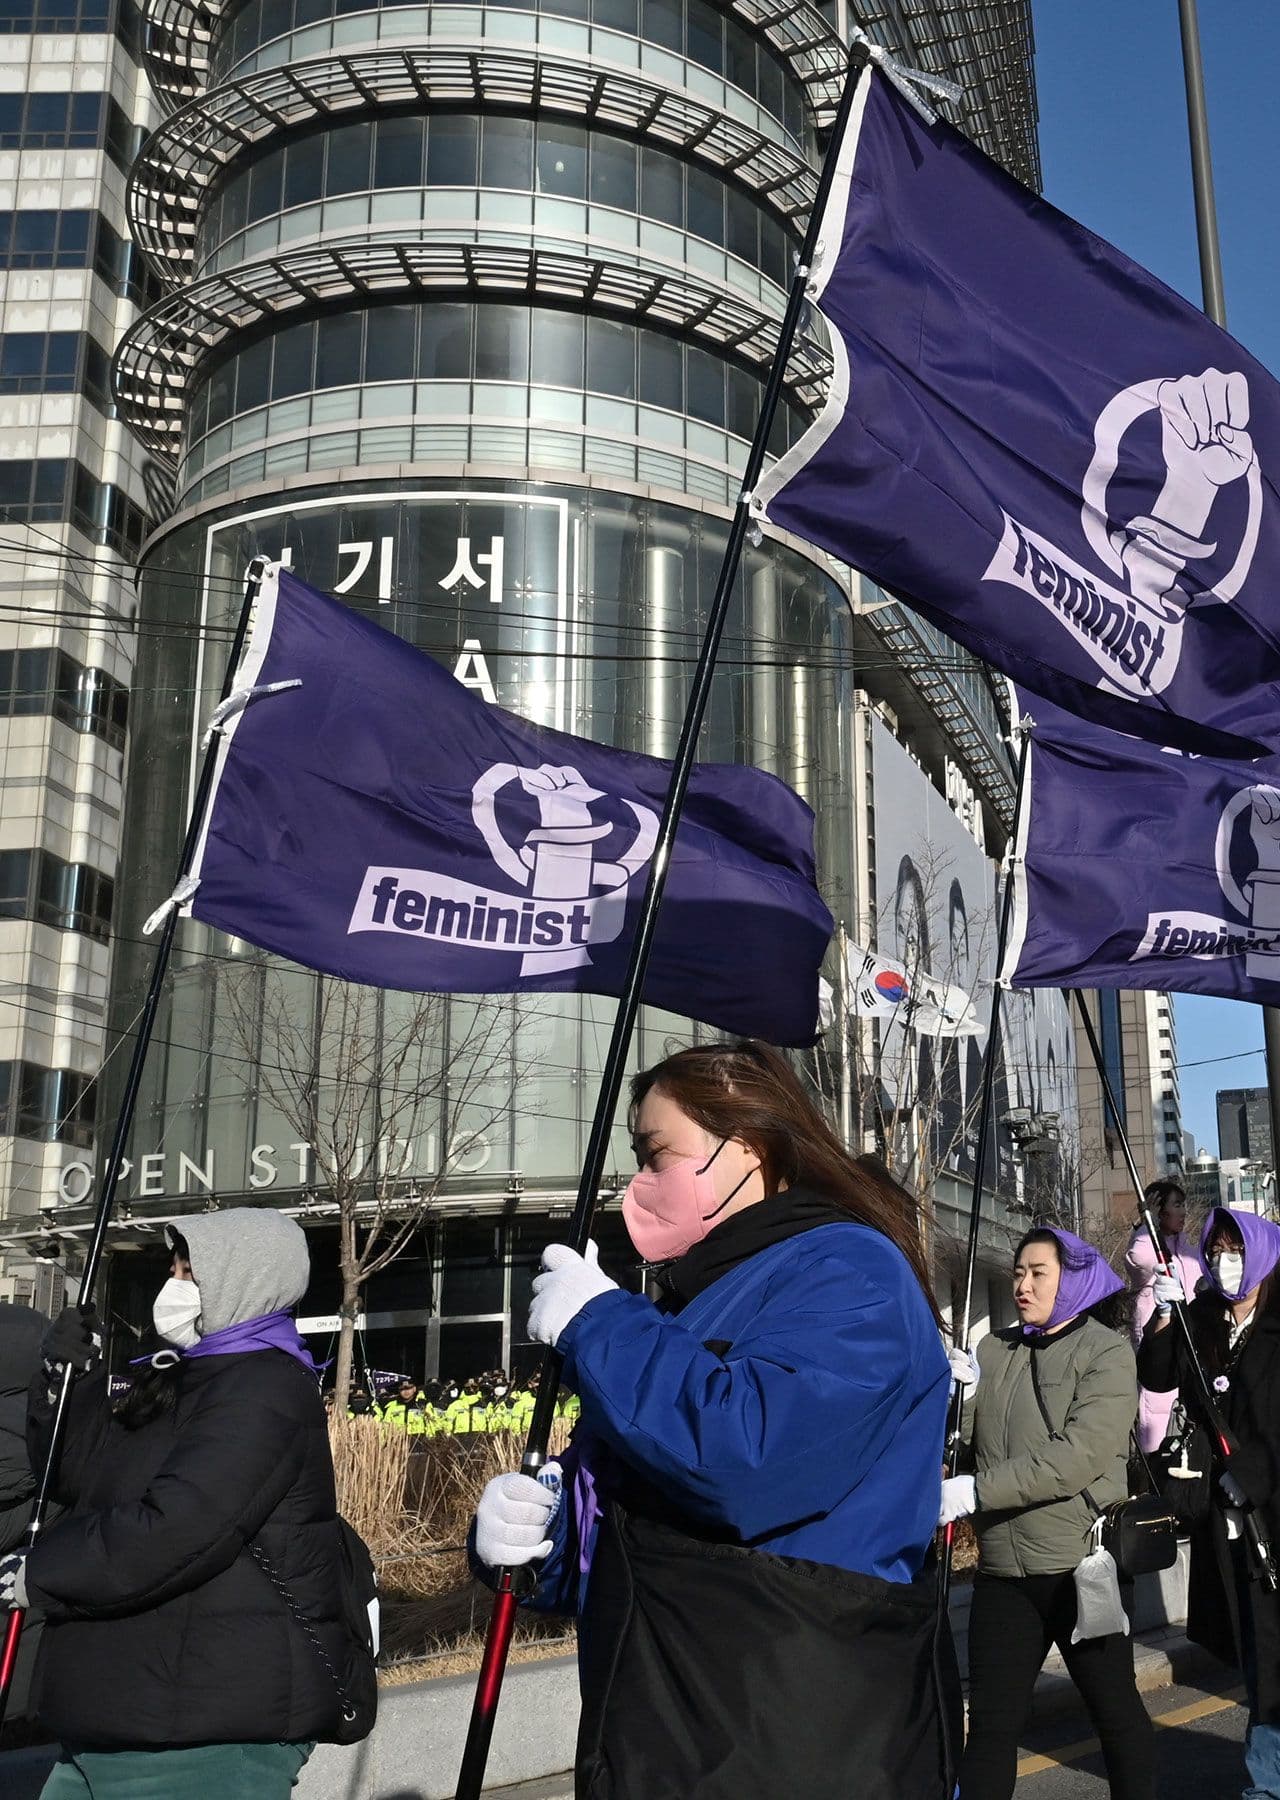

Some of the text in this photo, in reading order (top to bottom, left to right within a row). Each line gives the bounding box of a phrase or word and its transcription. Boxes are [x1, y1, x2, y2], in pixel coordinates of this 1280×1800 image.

[1007, 515, 1167, 691] feminist
[371, 876, 591, 946] feminist
[59, 1130, 490, 1203] OPEN STUDIO
